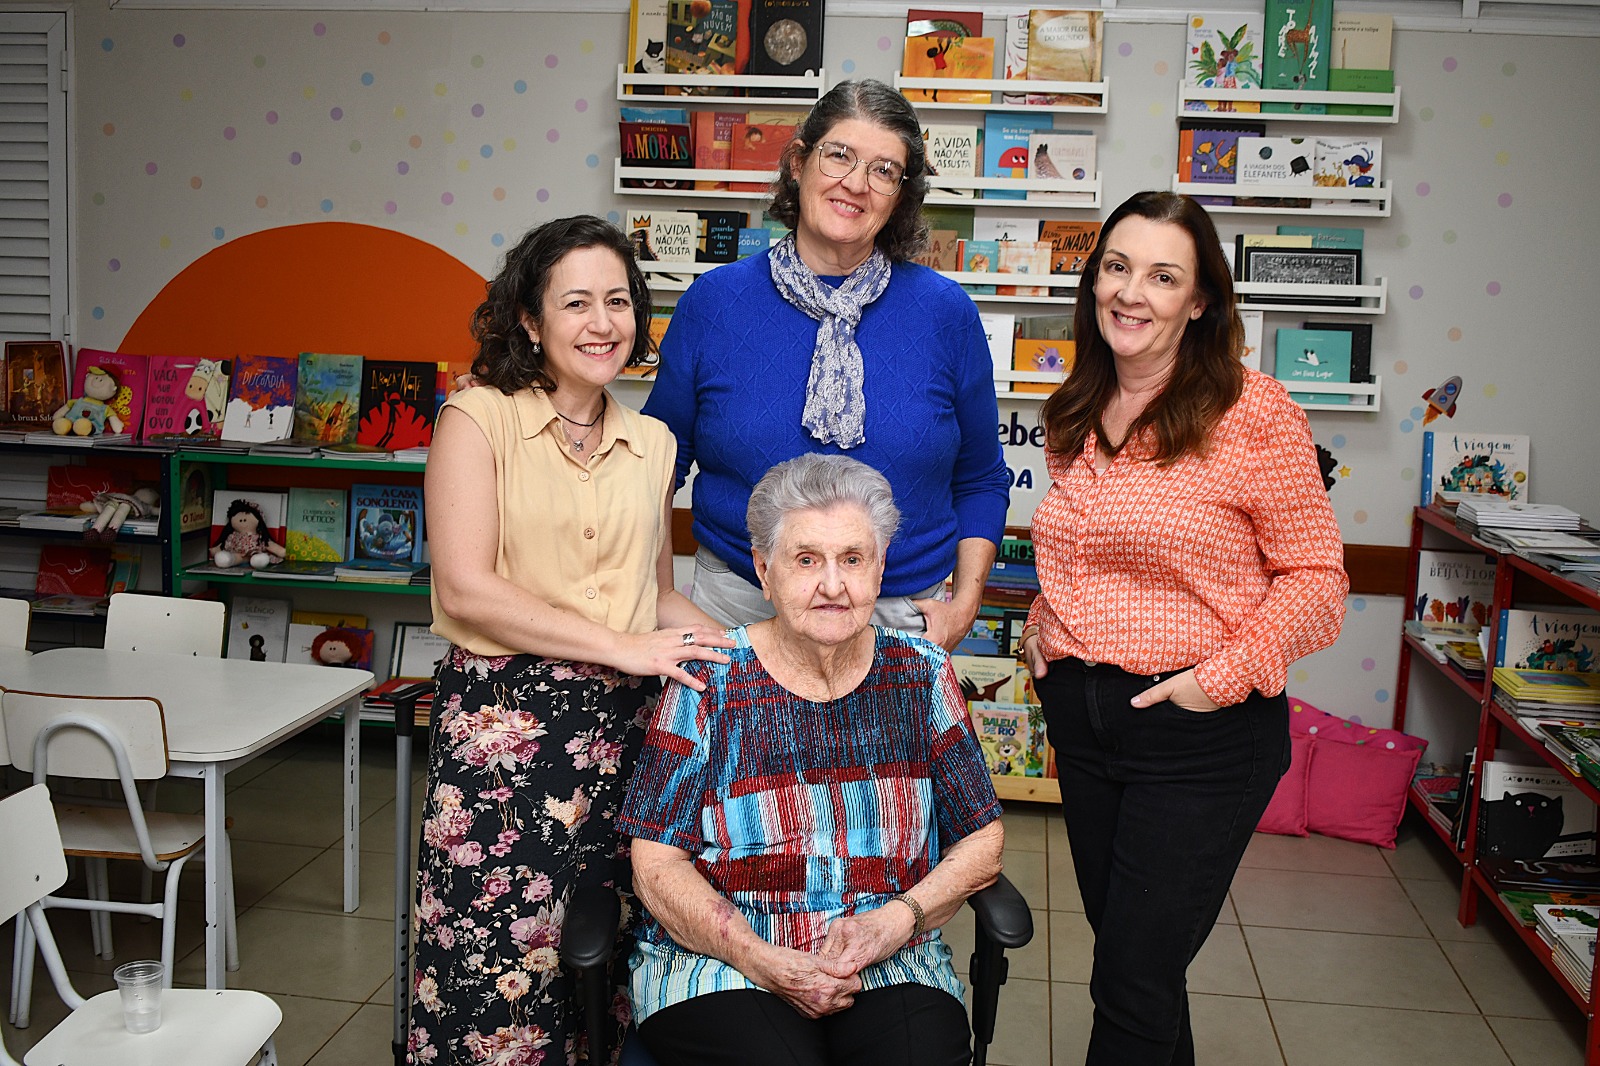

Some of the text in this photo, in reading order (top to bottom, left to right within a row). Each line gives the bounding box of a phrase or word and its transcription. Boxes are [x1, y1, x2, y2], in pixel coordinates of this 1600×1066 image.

[712, 10, 732, 22] PÃO DE
[703, 21, 732, 32] NUVEM
[626, 134, 689, 160] AMORAS
[934, 137, 971, 148] A VIDA
[934, 148, 969, 159] NÃO ME
[936, 159, 971, 168] ASSUSTA
[1244, 170, 1287, 179] ELEFANTES
[656, 224, 691, 235] A VIDA
[656, 235, 688, 245] NÃO ME
[1052, 231, 1096, 252] CLINADO
[657, 246, 690, 256] ASSUSTA
[153, 369, 178, 382] VACA
[149, 417, 173, 429] OVO
[998, 412, 1045, 447] ebe
[1464, 438, 1512, 456] viagem
[381, 488, 390, 498] A
[391, 488, 418, 499] CASA
[356, 497, 418, 510] SONOLENTA
[183, 514, 188, 524] O
[998, 544, 1035, 559] LHOS
[982, 717, 1018, 728] BALEIA
[984, 726, 1016, 736] DE RIO
